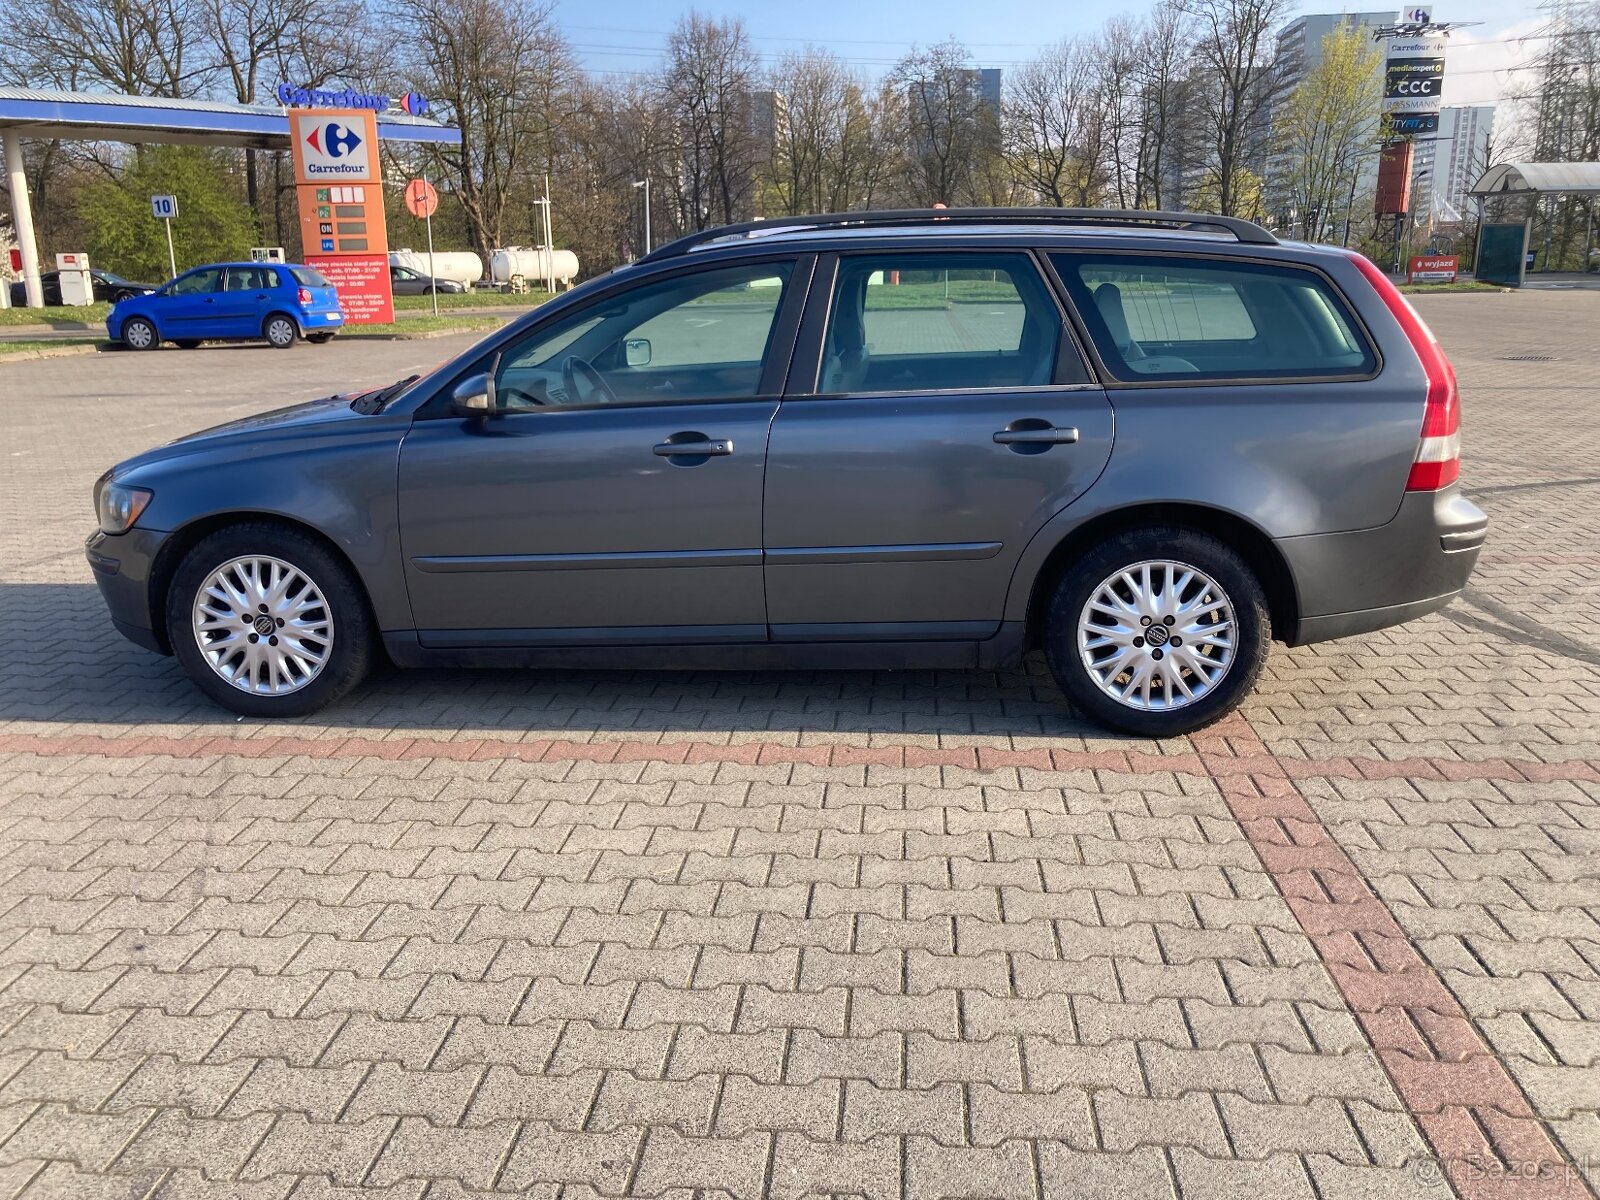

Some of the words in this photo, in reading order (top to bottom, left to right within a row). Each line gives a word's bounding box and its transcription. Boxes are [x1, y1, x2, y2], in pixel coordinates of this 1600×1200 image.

[1392, 43, 1430, 52] Carrefour
[1397, 81, 1432, 94] CCC
[278, 82, 389, 112] Carrefour
[308, 163, 365, 174] Carrefour
[154, 199, 171, 214] 10
[321, 225, 332, 234] ON
[1424, 260, 1454, 268] wyjazd
